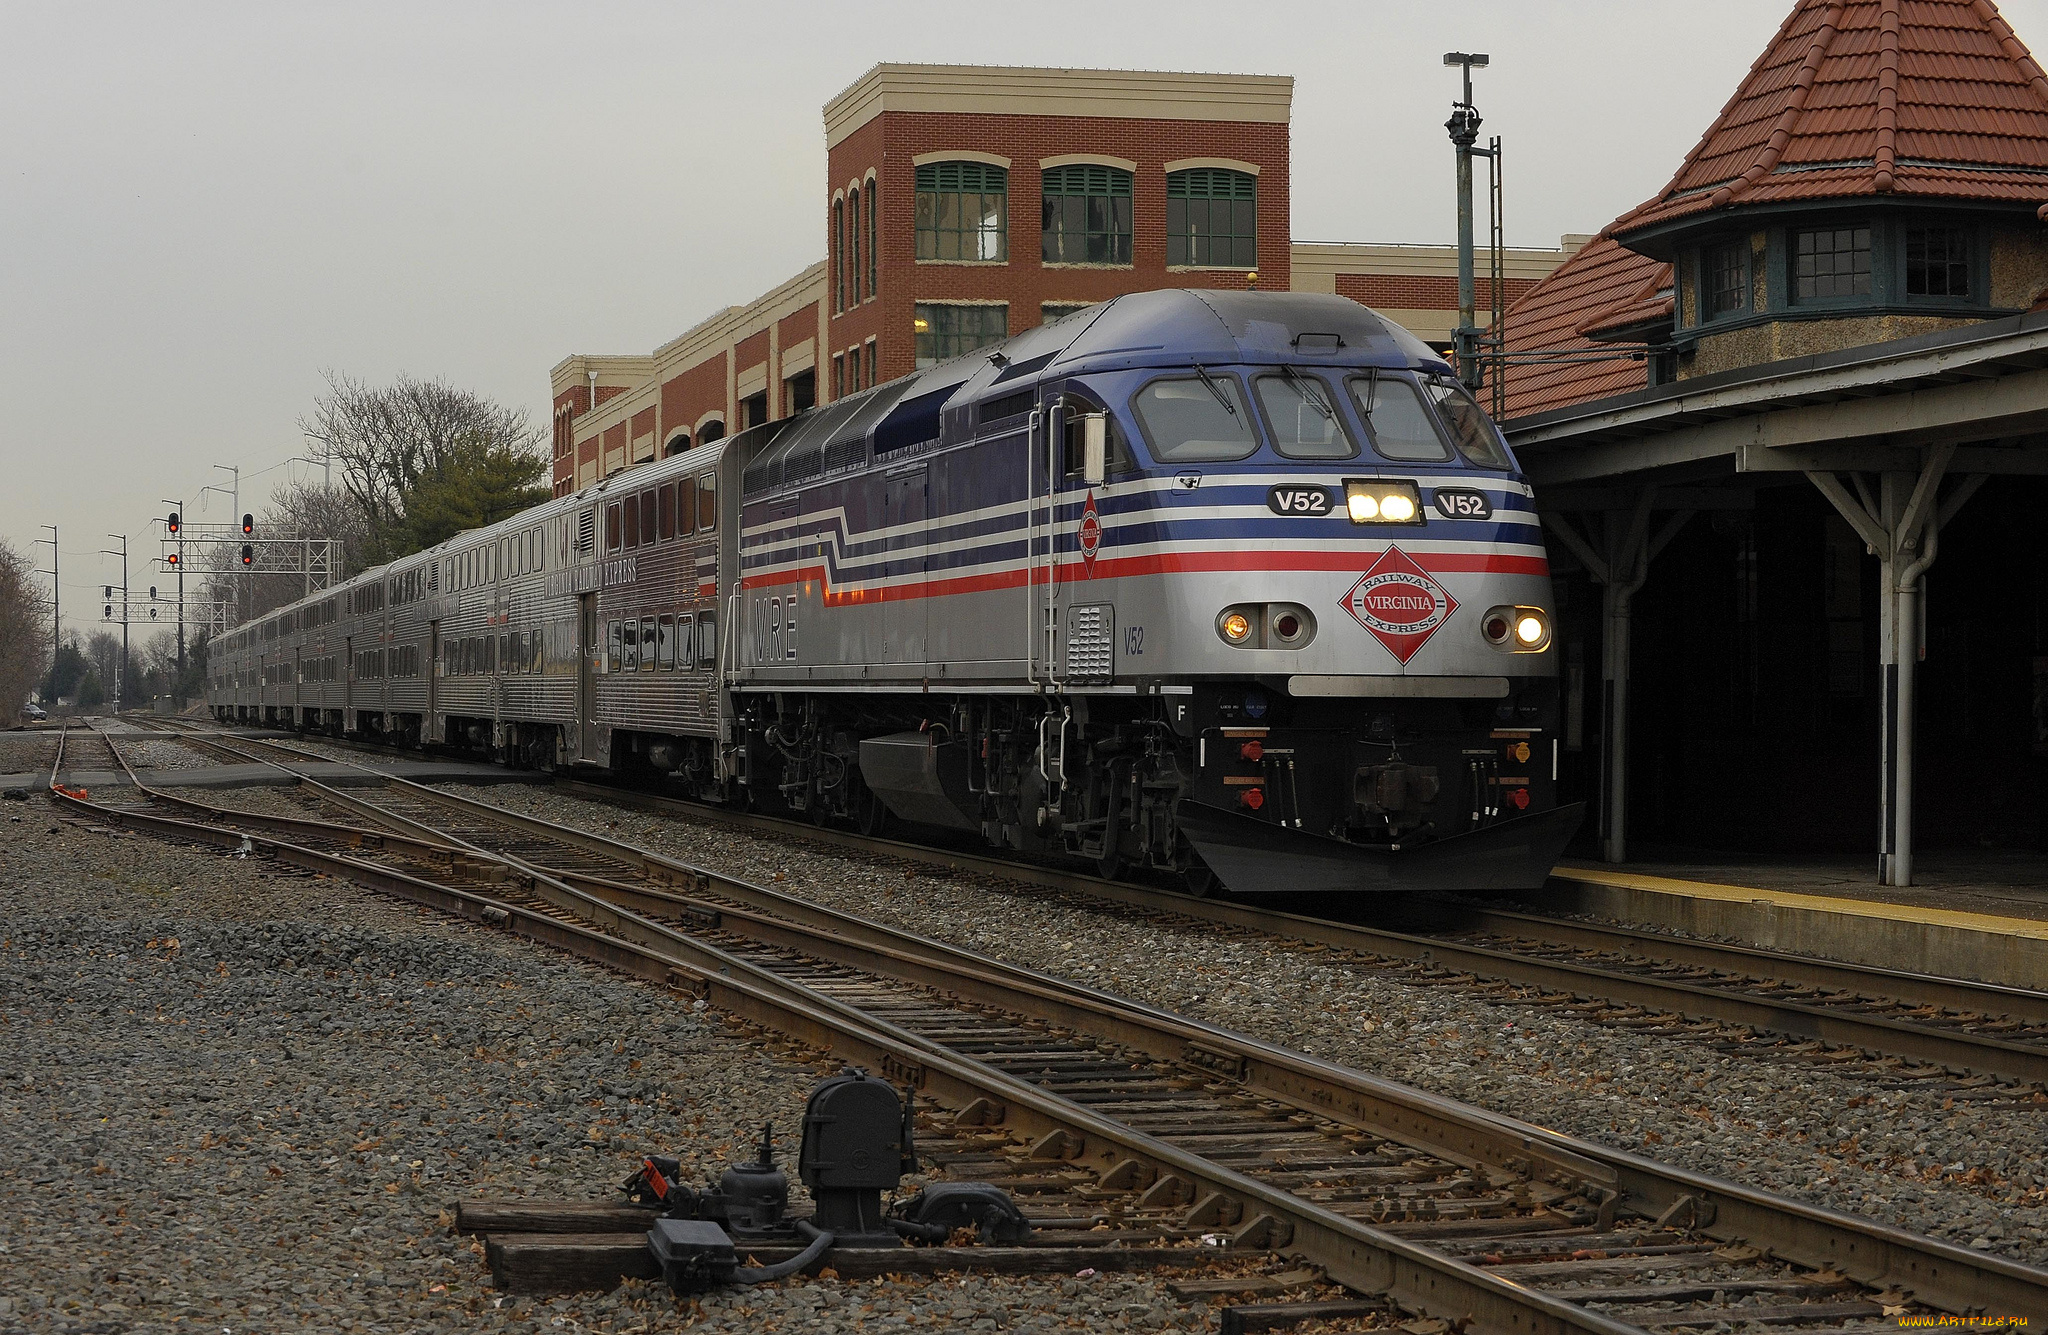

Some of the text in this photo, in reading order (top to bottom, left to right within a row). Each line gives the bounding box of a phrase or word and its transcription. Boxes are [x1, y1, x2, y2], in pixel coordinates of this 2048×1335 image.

[1275, 491, 1326, 511] V52
[1438, 495, 1487, 515] V52
[604, 557, 637, 586] EXPRESS
[1362, 574, 1436, 591] RAILWAY
[1366, 596, 1433, 610] VIRGINIA
[755, 594, 797, 662] VRE
[1363, 613, 1438, 632] EXPRESS
[1123, 626, 1144, 655] V52
[1178, 705, 1186, 721] F
